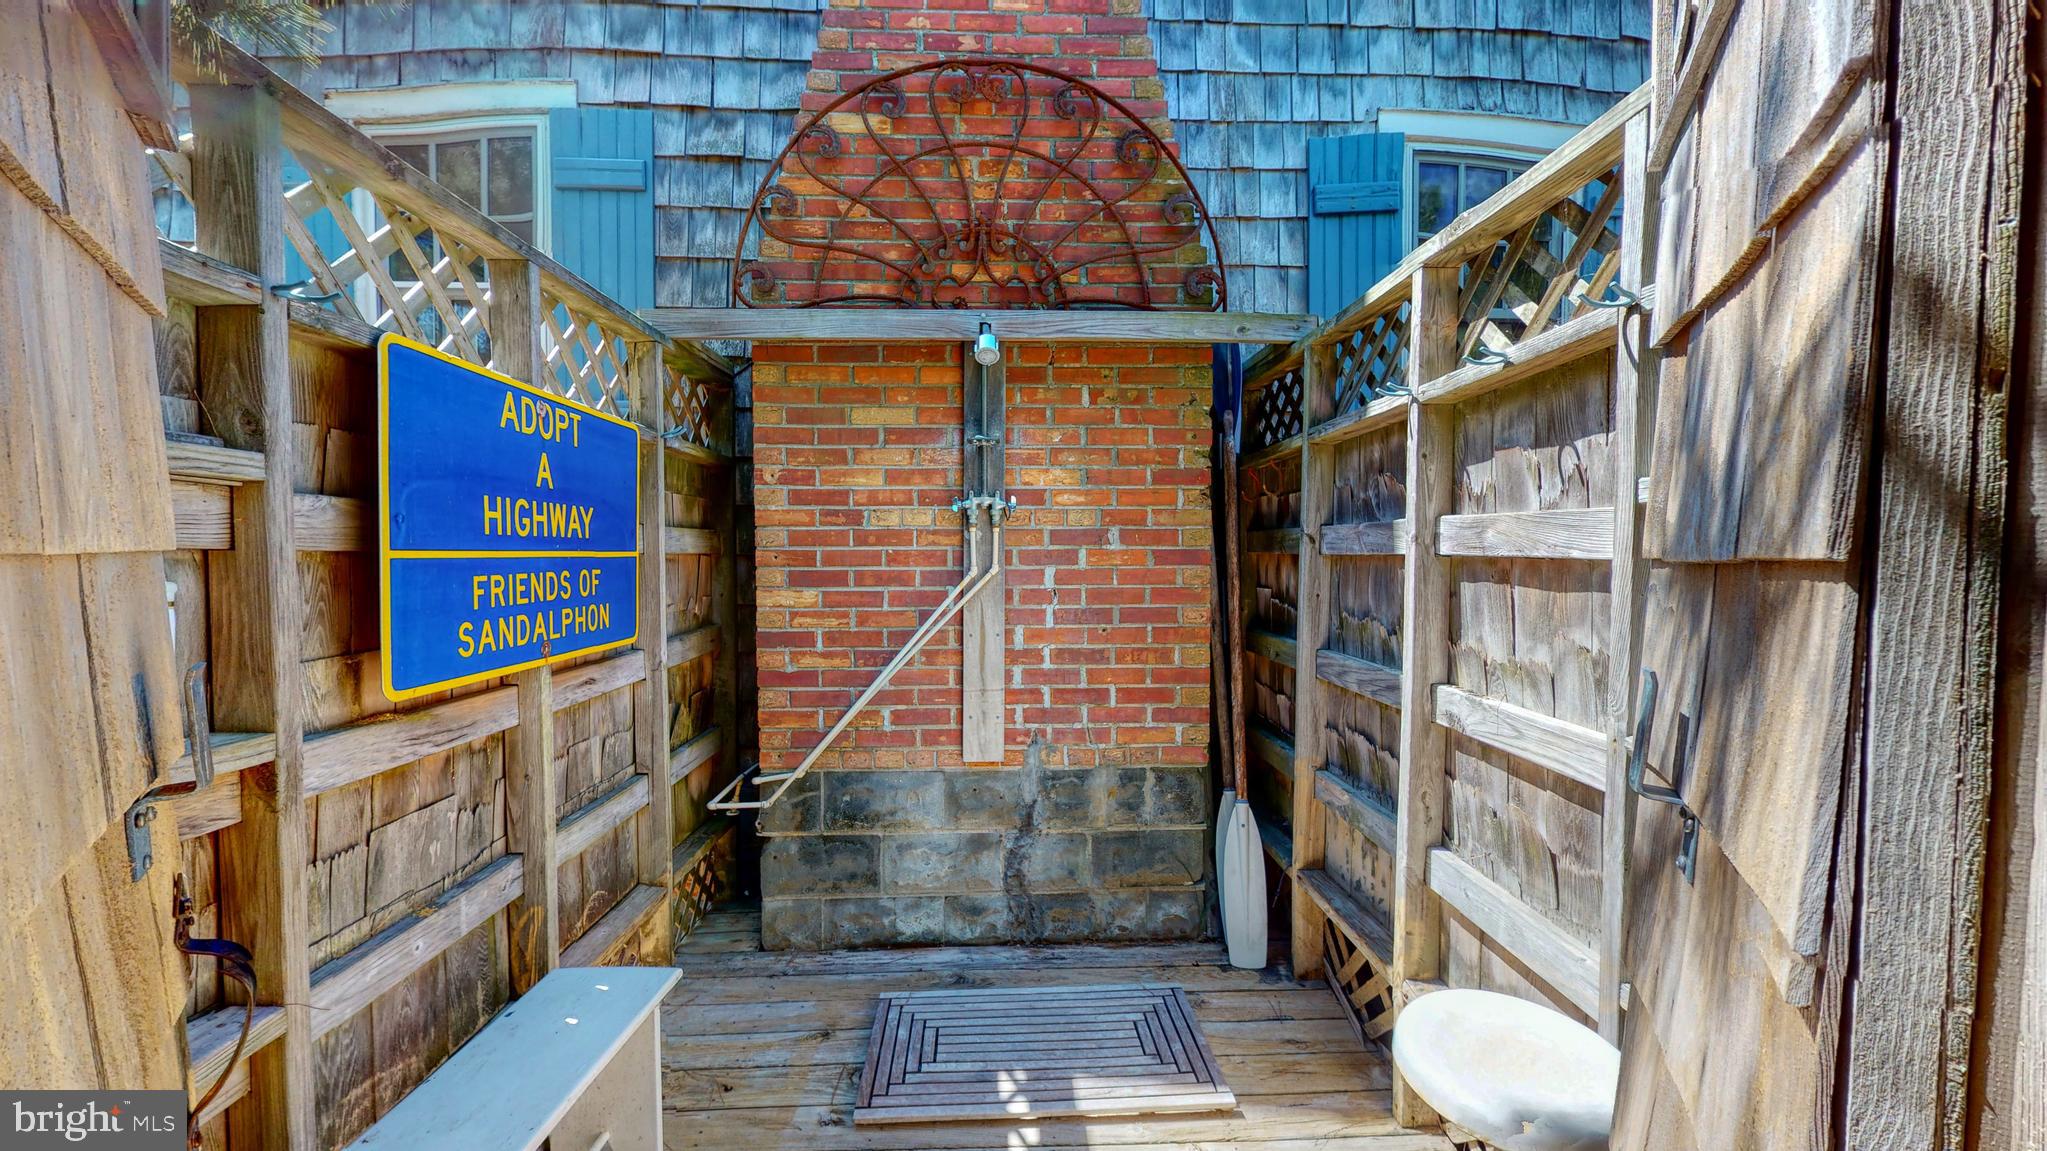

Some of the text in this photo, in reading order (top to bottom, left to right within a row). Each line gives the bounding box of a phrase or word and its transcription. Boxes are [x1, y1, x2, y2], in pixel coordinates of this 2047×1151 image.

[499, 391, 582, 448] ADOPT
[536, 452, 554, 490] A
[483, 494, 595, 540] HIGHWAY
[472, 568, 602, 611] FRIENDS OF
[457, 602, 611, 658] SANDALPHON
